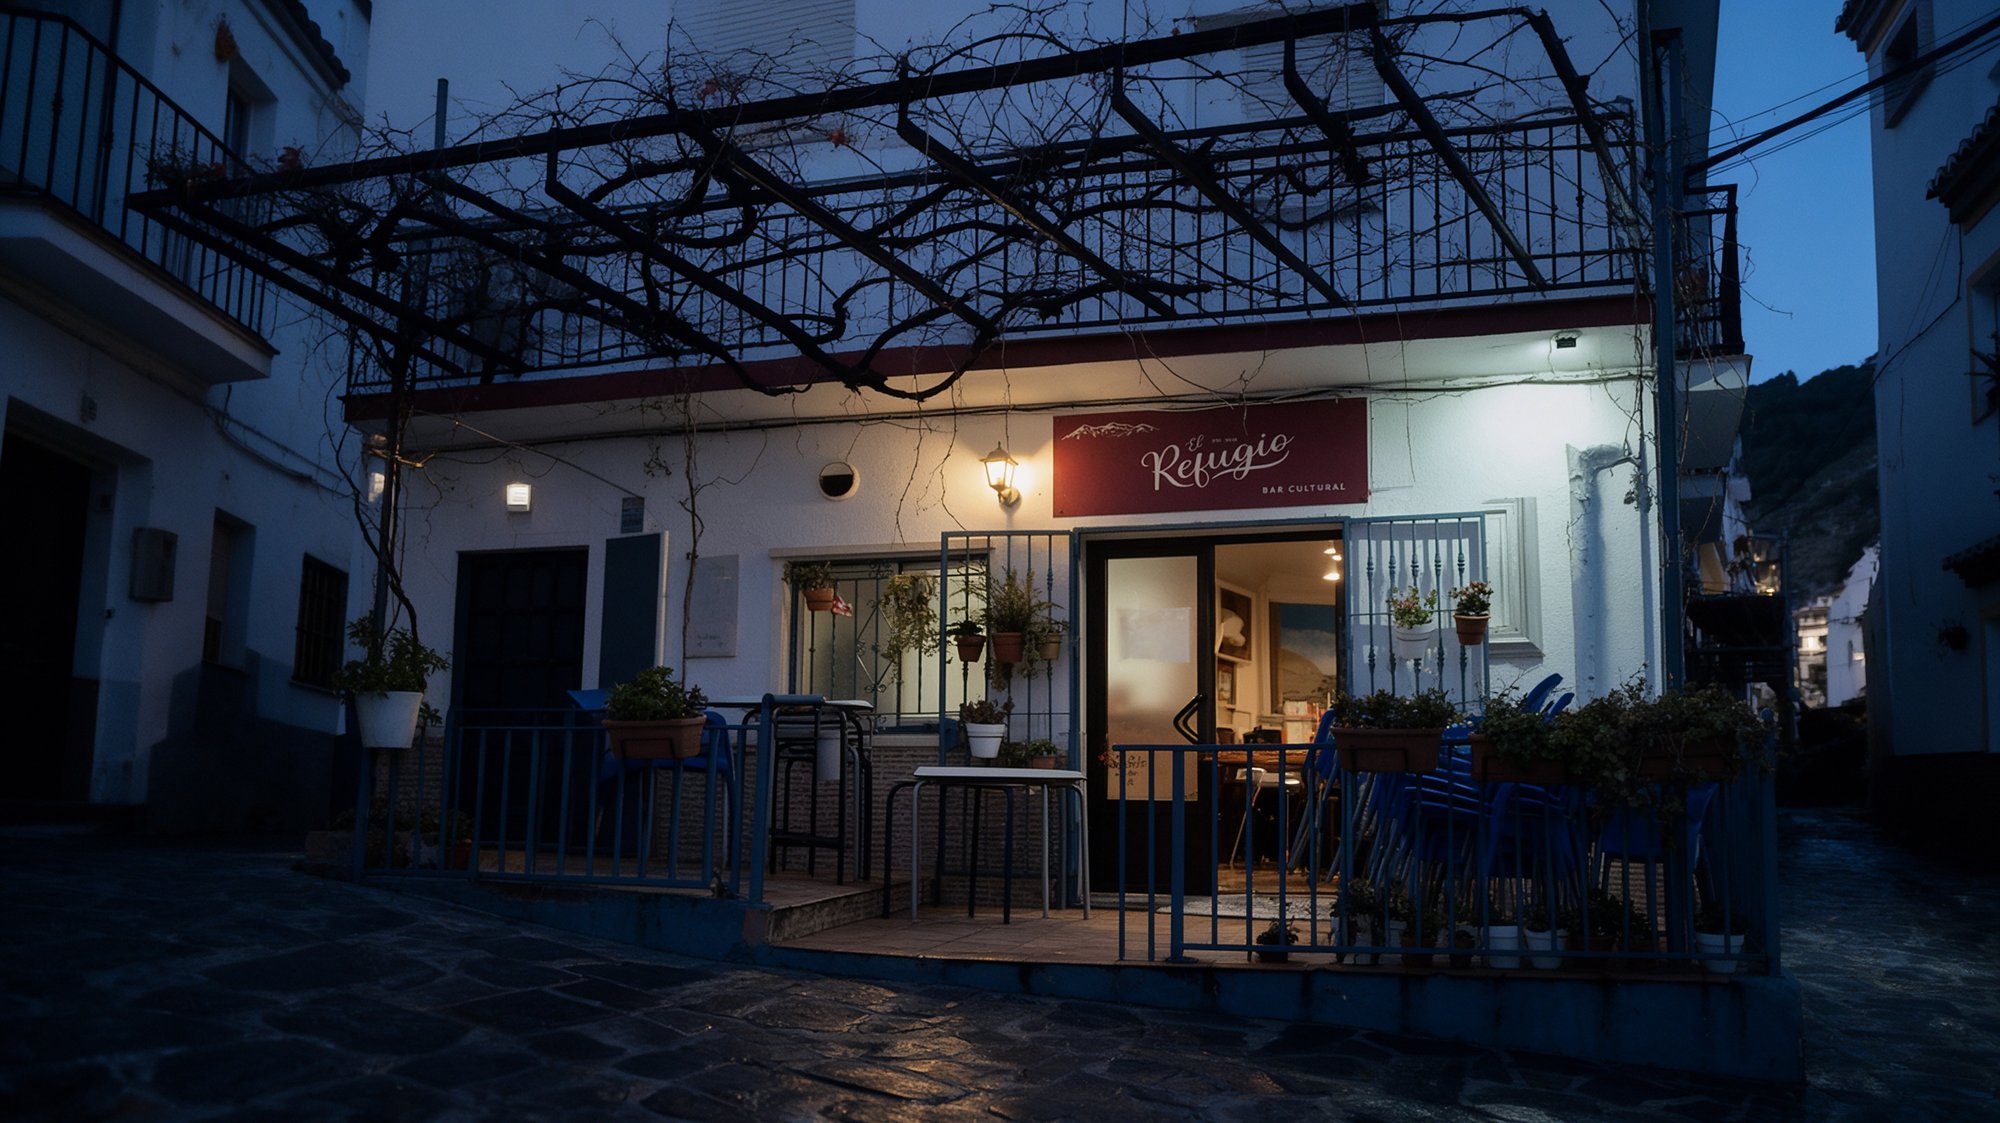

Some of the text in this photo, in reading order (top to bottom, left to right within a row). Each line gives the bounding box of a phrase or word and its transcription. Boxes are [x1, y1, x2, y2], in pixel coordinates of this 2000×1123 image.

[1185, 434, 1204, 452] El
[1141, 433, 1295, 491] Refugio
[1262, 482, 1346, 494] BAR CULTURAL
